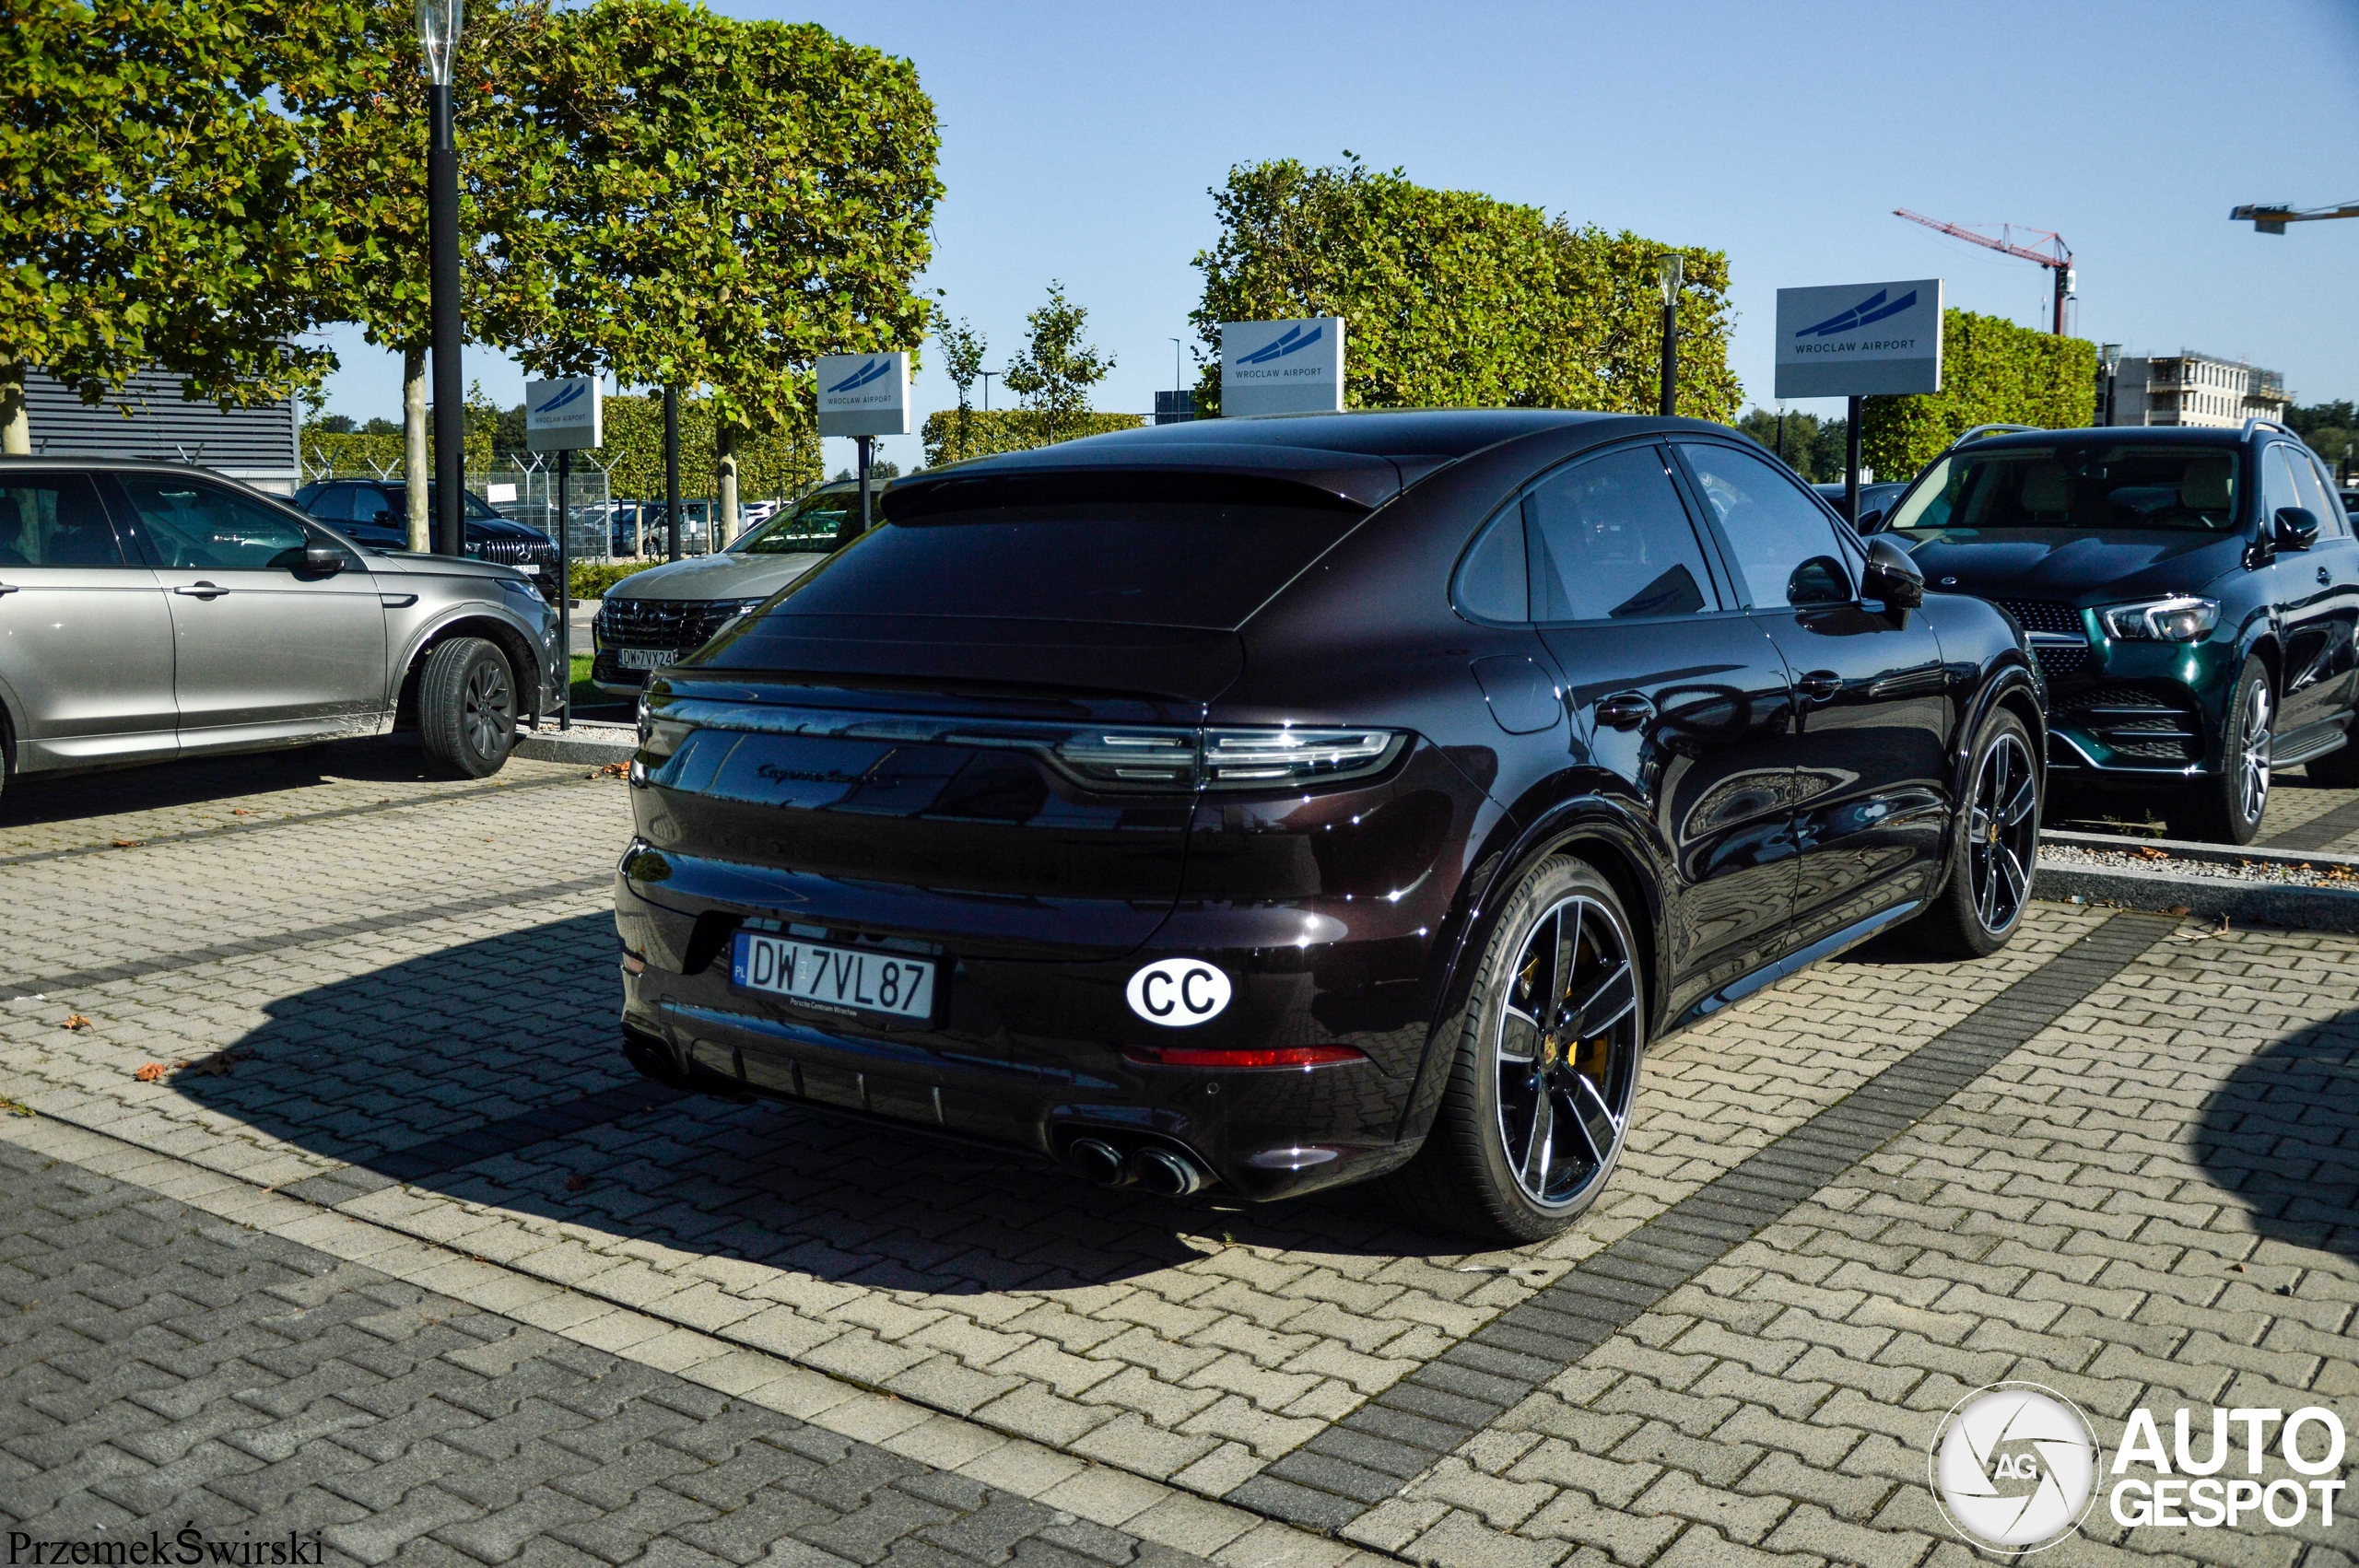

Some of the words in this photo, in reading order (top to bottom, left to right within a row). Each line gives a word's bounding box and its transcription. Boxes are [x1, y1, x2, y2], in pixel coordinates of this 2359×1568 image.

[1795, 342, 1857, 354] WROCLAW
[1861, 339, 1916, 351] AIRPORT
[1236, 369, 1280, 379] WROCLAW
[1283, 368, 1322, 376] AIRPORT
[827, 396, 861, 405] WROCLAW
[863, 394, 892, 404] AIRPORT
[535, 415, 561, 424] WROCLAW
[562, 414, 586, 423] AIRPORT
[623, 649, 637, 664] DW
[640, 650, 672, 666] 7VX24
[734, 965, 746, 979] PL
[753, 940, 798, 991] DW
[809, 949, 925, 1012] 7VL87
[1141, 967, 1216, 1017] CC
[790, 997, 811, 1009] Porsche
[811, 1001, 834, 1012] Centrum
